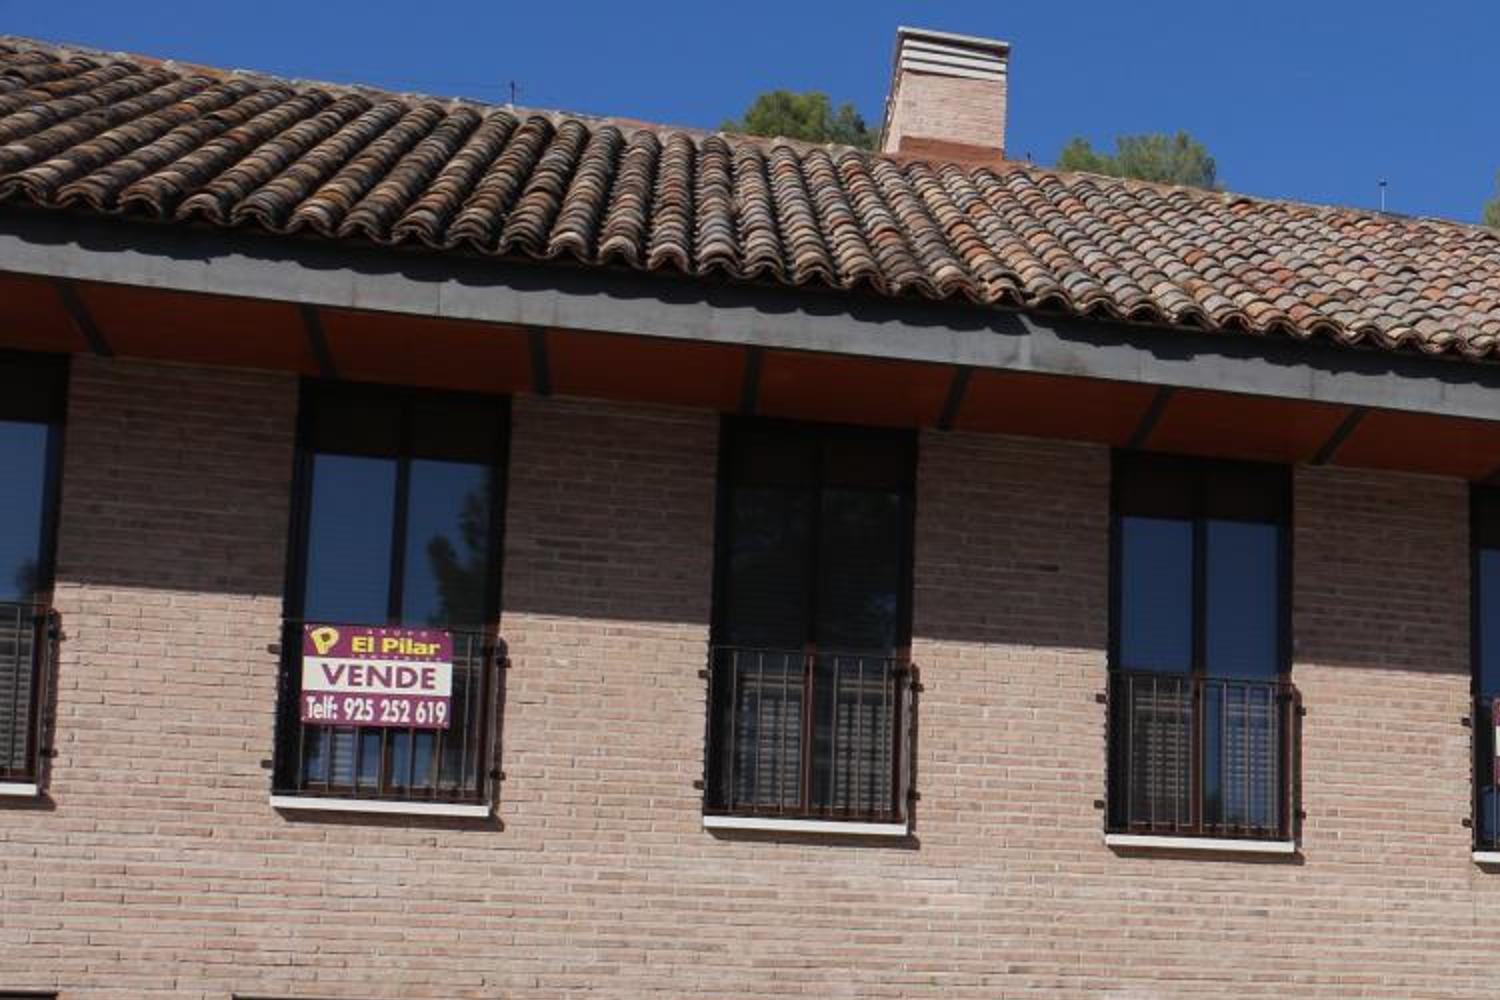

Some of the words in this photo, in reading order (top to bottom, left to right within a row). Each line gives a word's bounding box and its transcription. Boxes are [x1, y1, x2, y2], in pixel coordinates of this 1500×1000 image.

[352, 636, 374, 653] El
[381, 637, 441, 655] Pilar
[321, 664, 437, 690] VENDE
[306, 696, 338, 720] Telf:
[344, 698, 373, 721] 925
[380, 700, 410, 723] 252
[415, 701, 447, 724] 619
